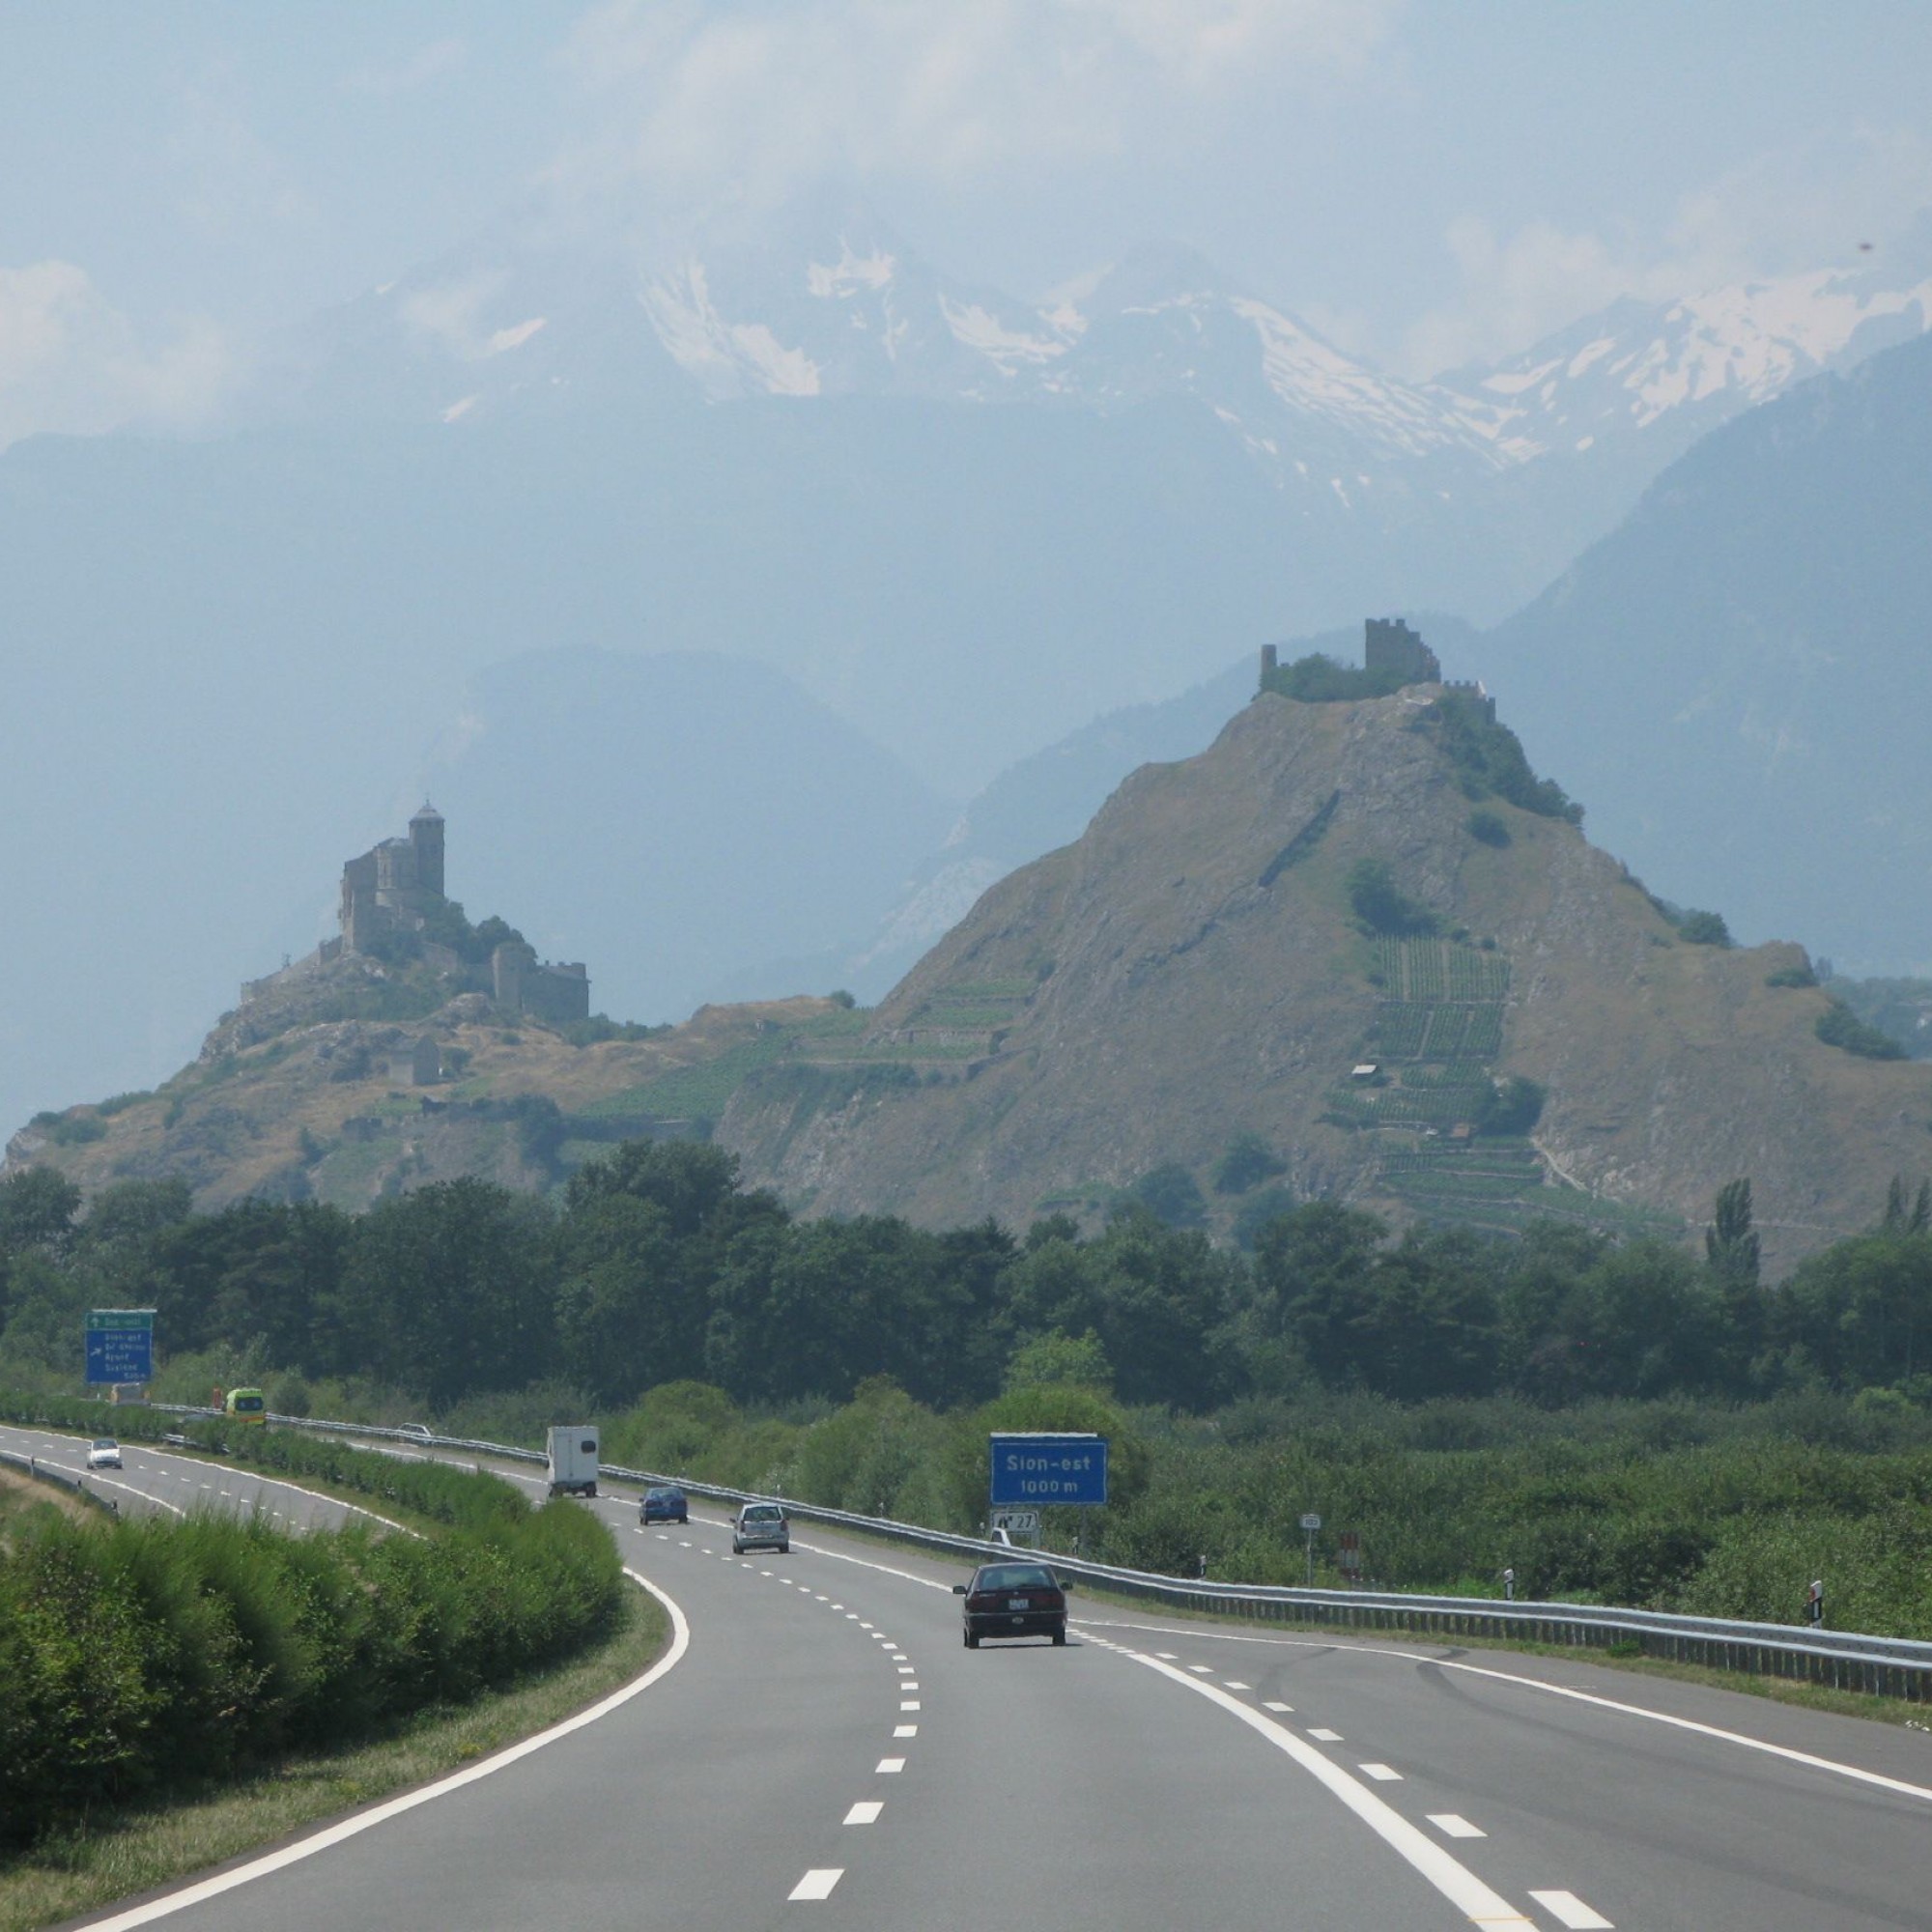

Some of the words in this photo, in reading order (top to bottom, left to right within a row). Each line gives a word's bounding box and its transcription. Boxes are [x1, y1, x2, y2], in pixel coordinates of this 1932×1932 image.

[1007, 1455, 1092, 1470] Sion-est
[1021, 1480, 1060, 1493] 1000
[1064, 1482, 1078, 1492] m
[1017, 1515, 1034, 1528] 27
